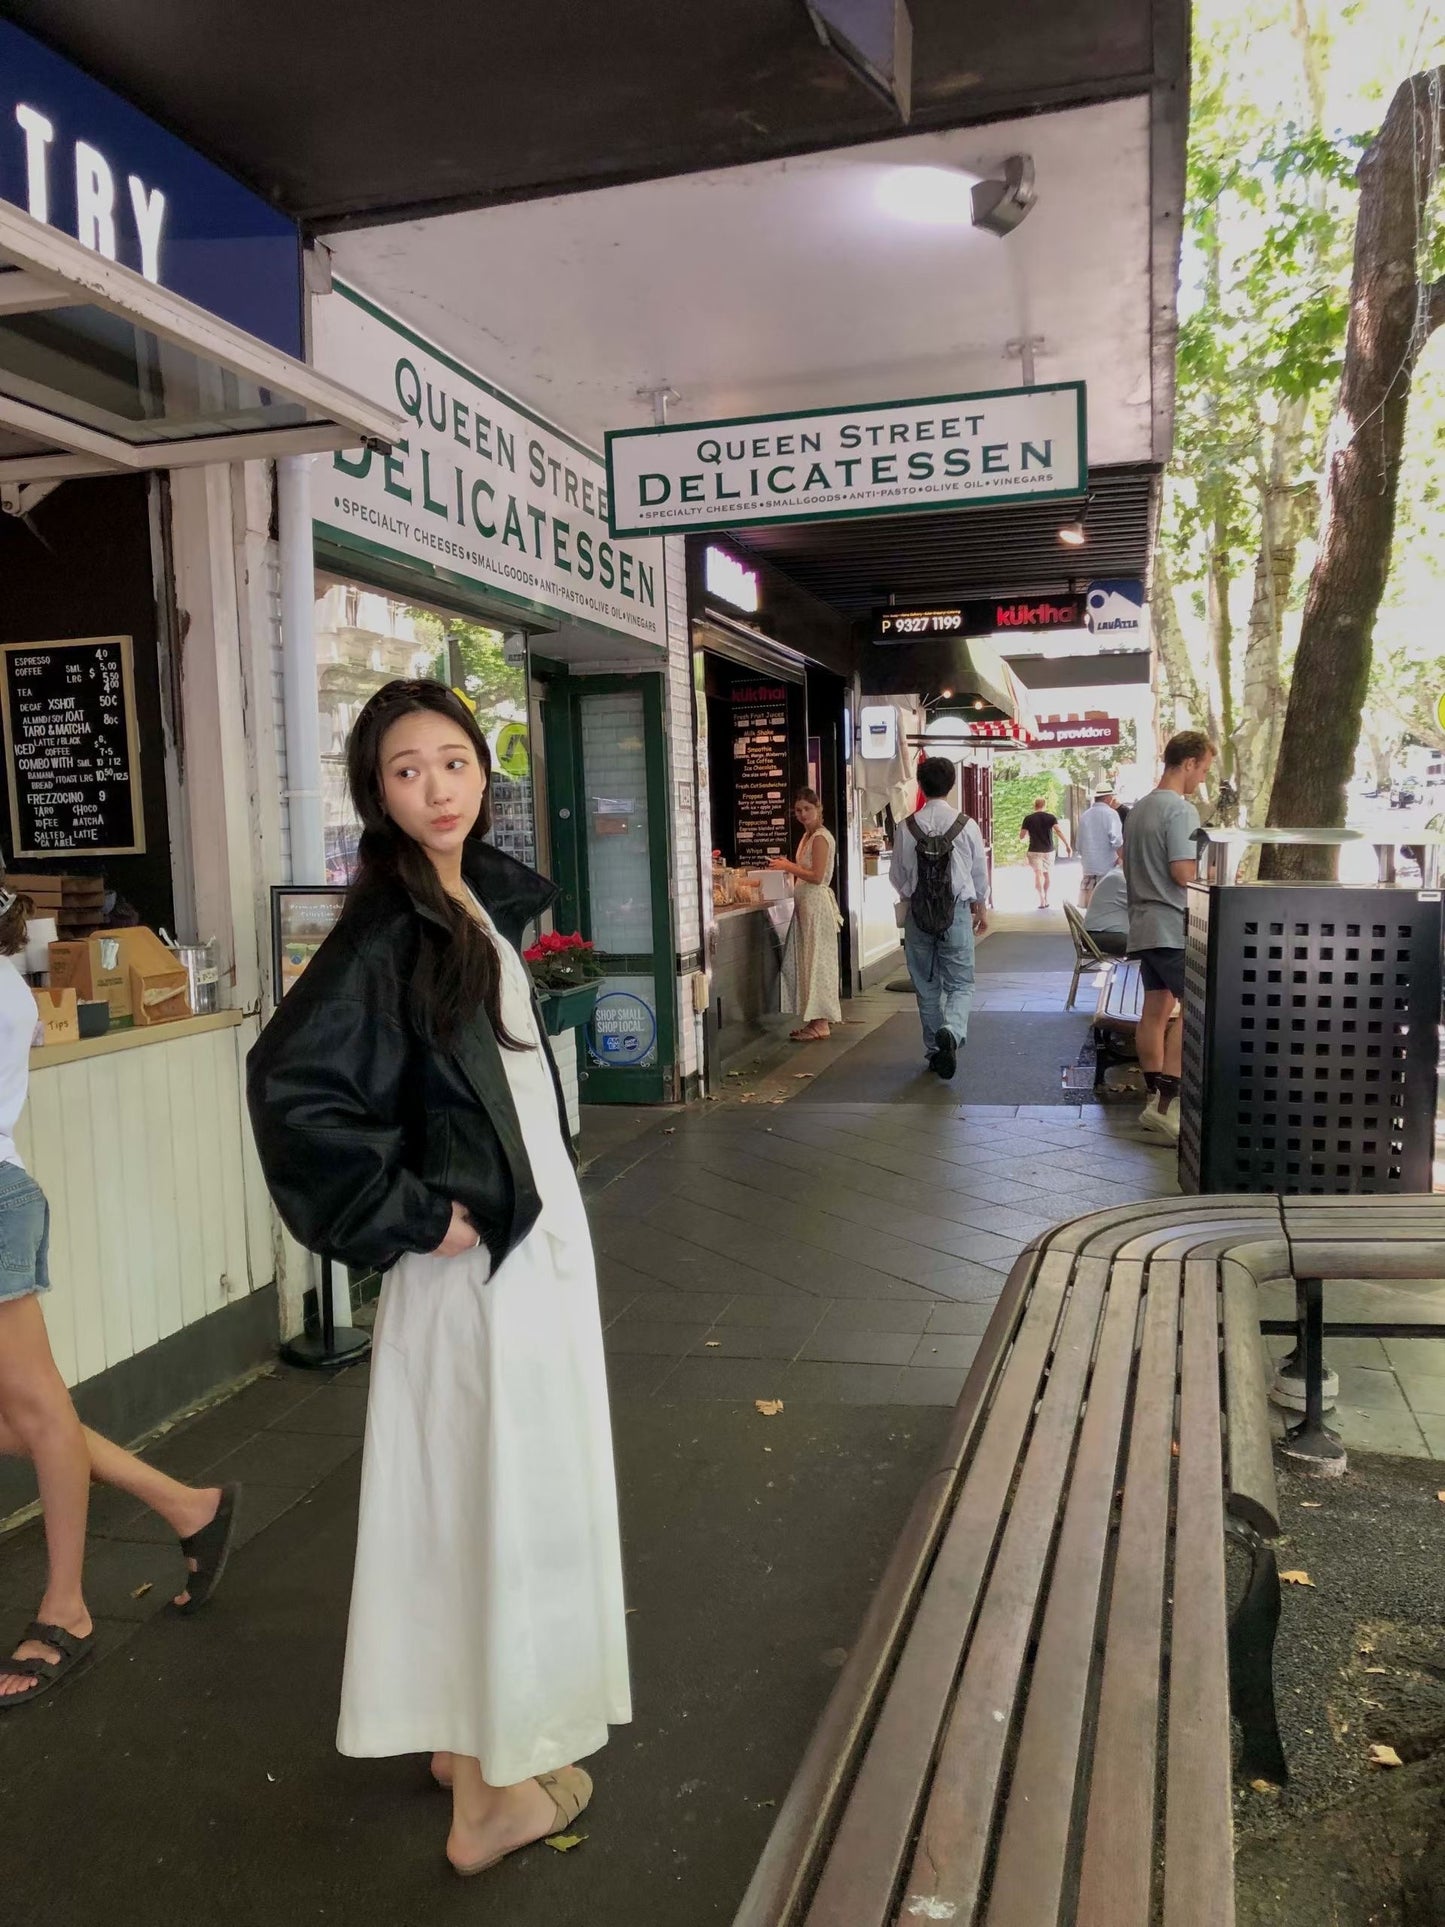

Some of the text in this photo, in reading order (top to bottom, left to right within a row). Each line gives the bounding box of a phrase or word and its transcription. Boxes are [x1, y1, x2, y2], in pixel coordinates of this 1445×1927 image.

[395, 358, 608, 524] QUEEN STREE
[697, 414, 986, 465] QUEEN STREET
[638, 439, 1054, 508] DELICATESSEN
[645, 473, 1054, 519] SPECIALTY CHEESES SMALLGOODS ANTI-PASTO OLIVE OIL VINEGARS
[342, 497, 657, 633] SPECIALTY CHEESES SMALLGOODS ANTI-PASTO OLIVE OIL VINEGARS
[882, 615, 961, 633] P 9327 1199
[1097, 617, 1139, 631] LAVAZZA
[14, 656, 51, 667] ESPRESSO
[15, 667, 43, 677] COFFEE
[65, 664, 82, 674] SML
[17, 688, 33, 697] TEA
[20, 703, 42, 712] DECAF
[22, 725, 47, 738] TARO
[1056, 727, 1112, 742] providore
[33, 737, 55, 747] LATTE
[14, 743, 36, 756] ICED
[44, 747, 71, 757] COFFEE
[18, 758, 50, 771] COMBO
[50, 756, 74, 769] WITH
[27, 790, 106, 805] FREZZOCINO 9
[34, 804, 98, 817] TARO CHOCO
[72, 814, 105, 827] MATCHA
[34, 828, 99, 843] SALTED LATTE
[595, 1009, 617, 1021] SHOP
[47, 1021, 69, 1031] Tips
[597, 1021, 618, 1033] SHOP
